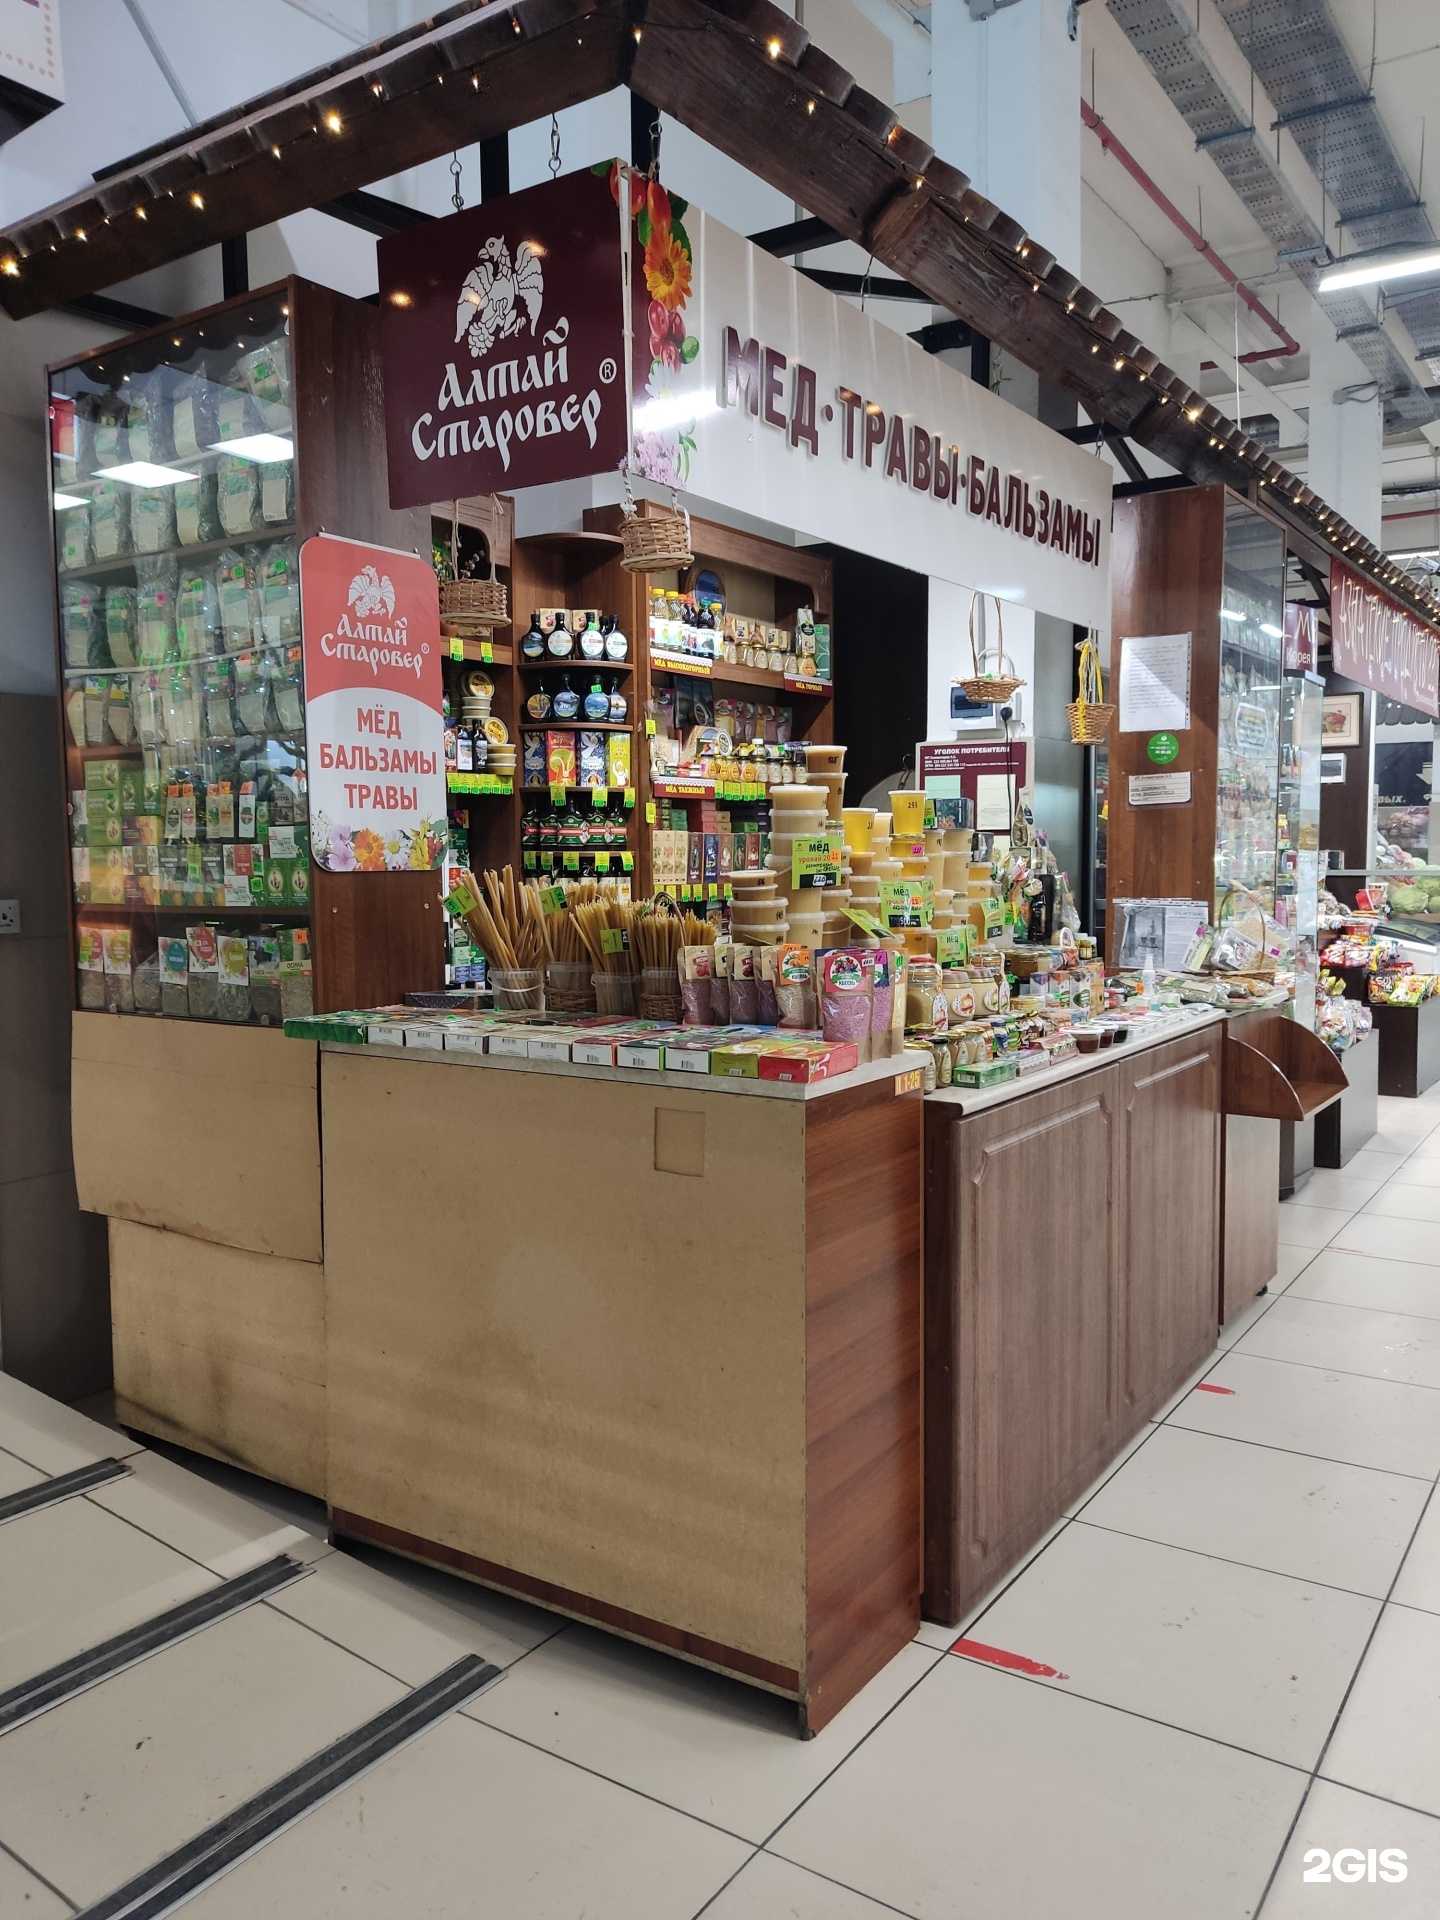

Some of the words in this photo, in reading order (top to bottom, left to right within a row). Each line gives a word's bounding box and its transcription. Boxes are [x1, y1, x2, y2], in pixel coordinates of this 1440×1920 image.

[438, 316, 569, 411] Алтай
[411, 389, 602, 472] Старовер
[723, 326, 819, 457] МЕД
[836, 386, 959, 505] ТРАВЫ
[966, 454, 1102, 567] БАЛЬЗАМЫ
[337, 614, 408, 646] Алтай
[320, 633, 424, 679] Старовер
[357, 704, 401, 740] МЁД
[319, 743, 437, 775] БАЛЬЗАМЫ
[344, 784, 418, 810] ТРАВЫ
[808, 841, 830, 853] мёд
